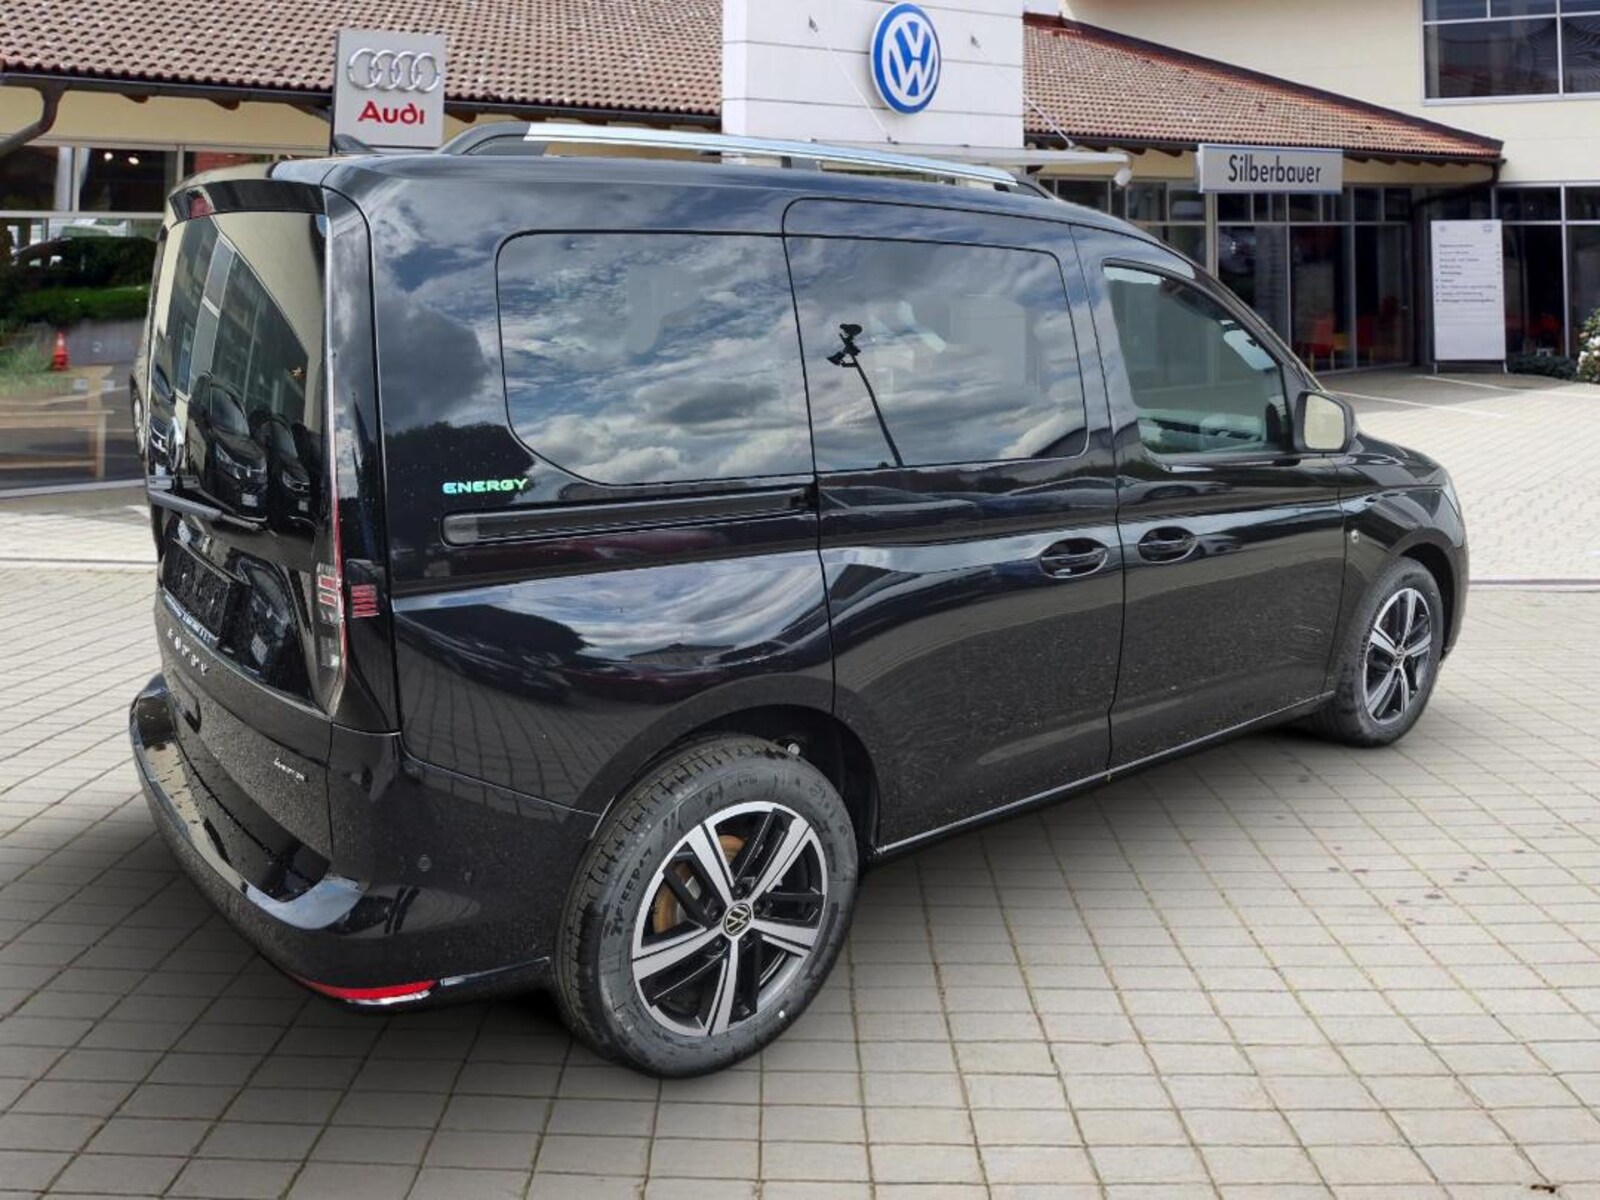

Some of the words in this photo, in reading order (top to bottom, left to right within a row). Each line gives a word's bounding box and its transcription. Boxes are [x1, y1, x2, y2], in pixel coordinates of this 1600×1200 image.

[881, 11, 937, 106] VW
[357, 101, 425, 125] Audi
[1227, 153, 1321, 183] Silberbauer
[442, 478, 528, 494] ENERGY
